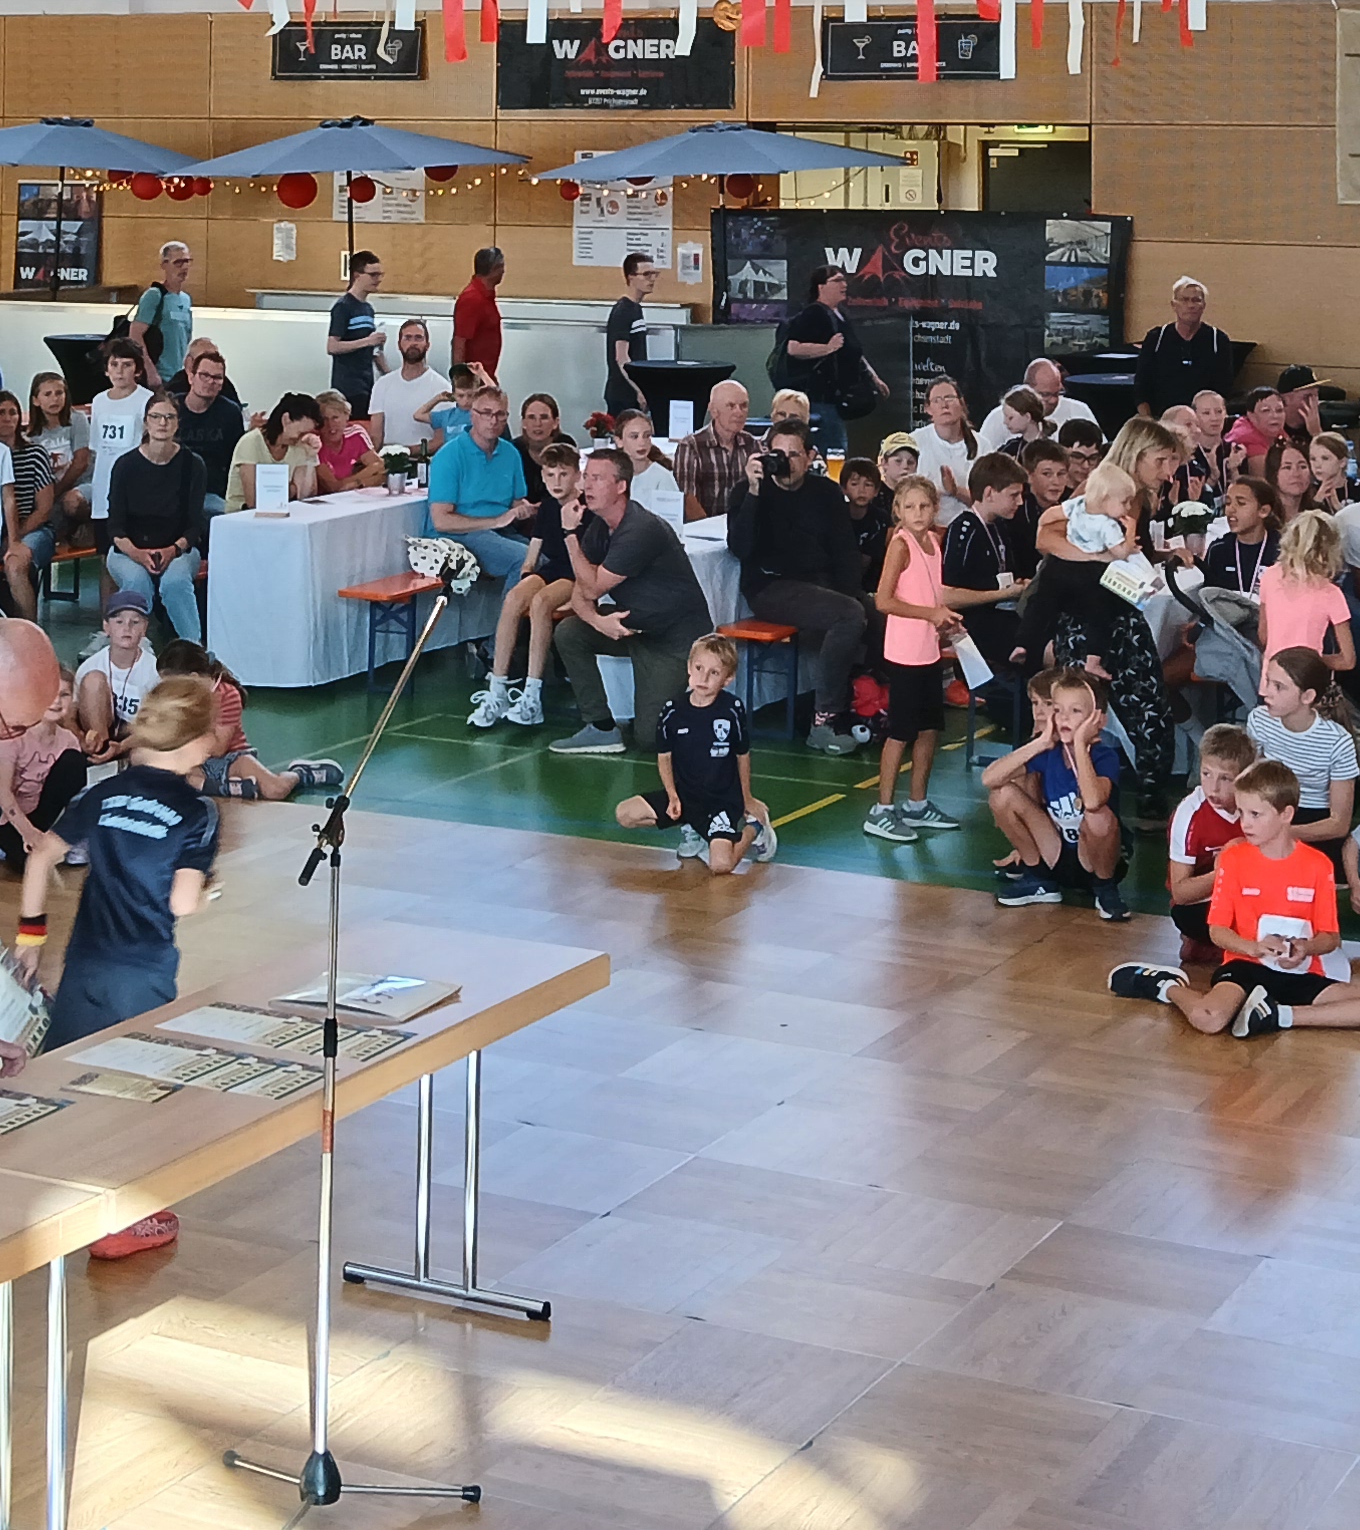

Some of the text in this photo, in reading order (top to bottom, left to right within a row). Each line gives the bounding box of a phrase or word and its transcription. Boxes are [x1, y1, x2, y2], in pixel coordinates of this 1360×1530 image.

[330, 44, 367, 60] BAR
[892, 40, 919, 58] BA
[824, 244, 998, 280] WAGNER
[101, 424, 125, 439] 731
